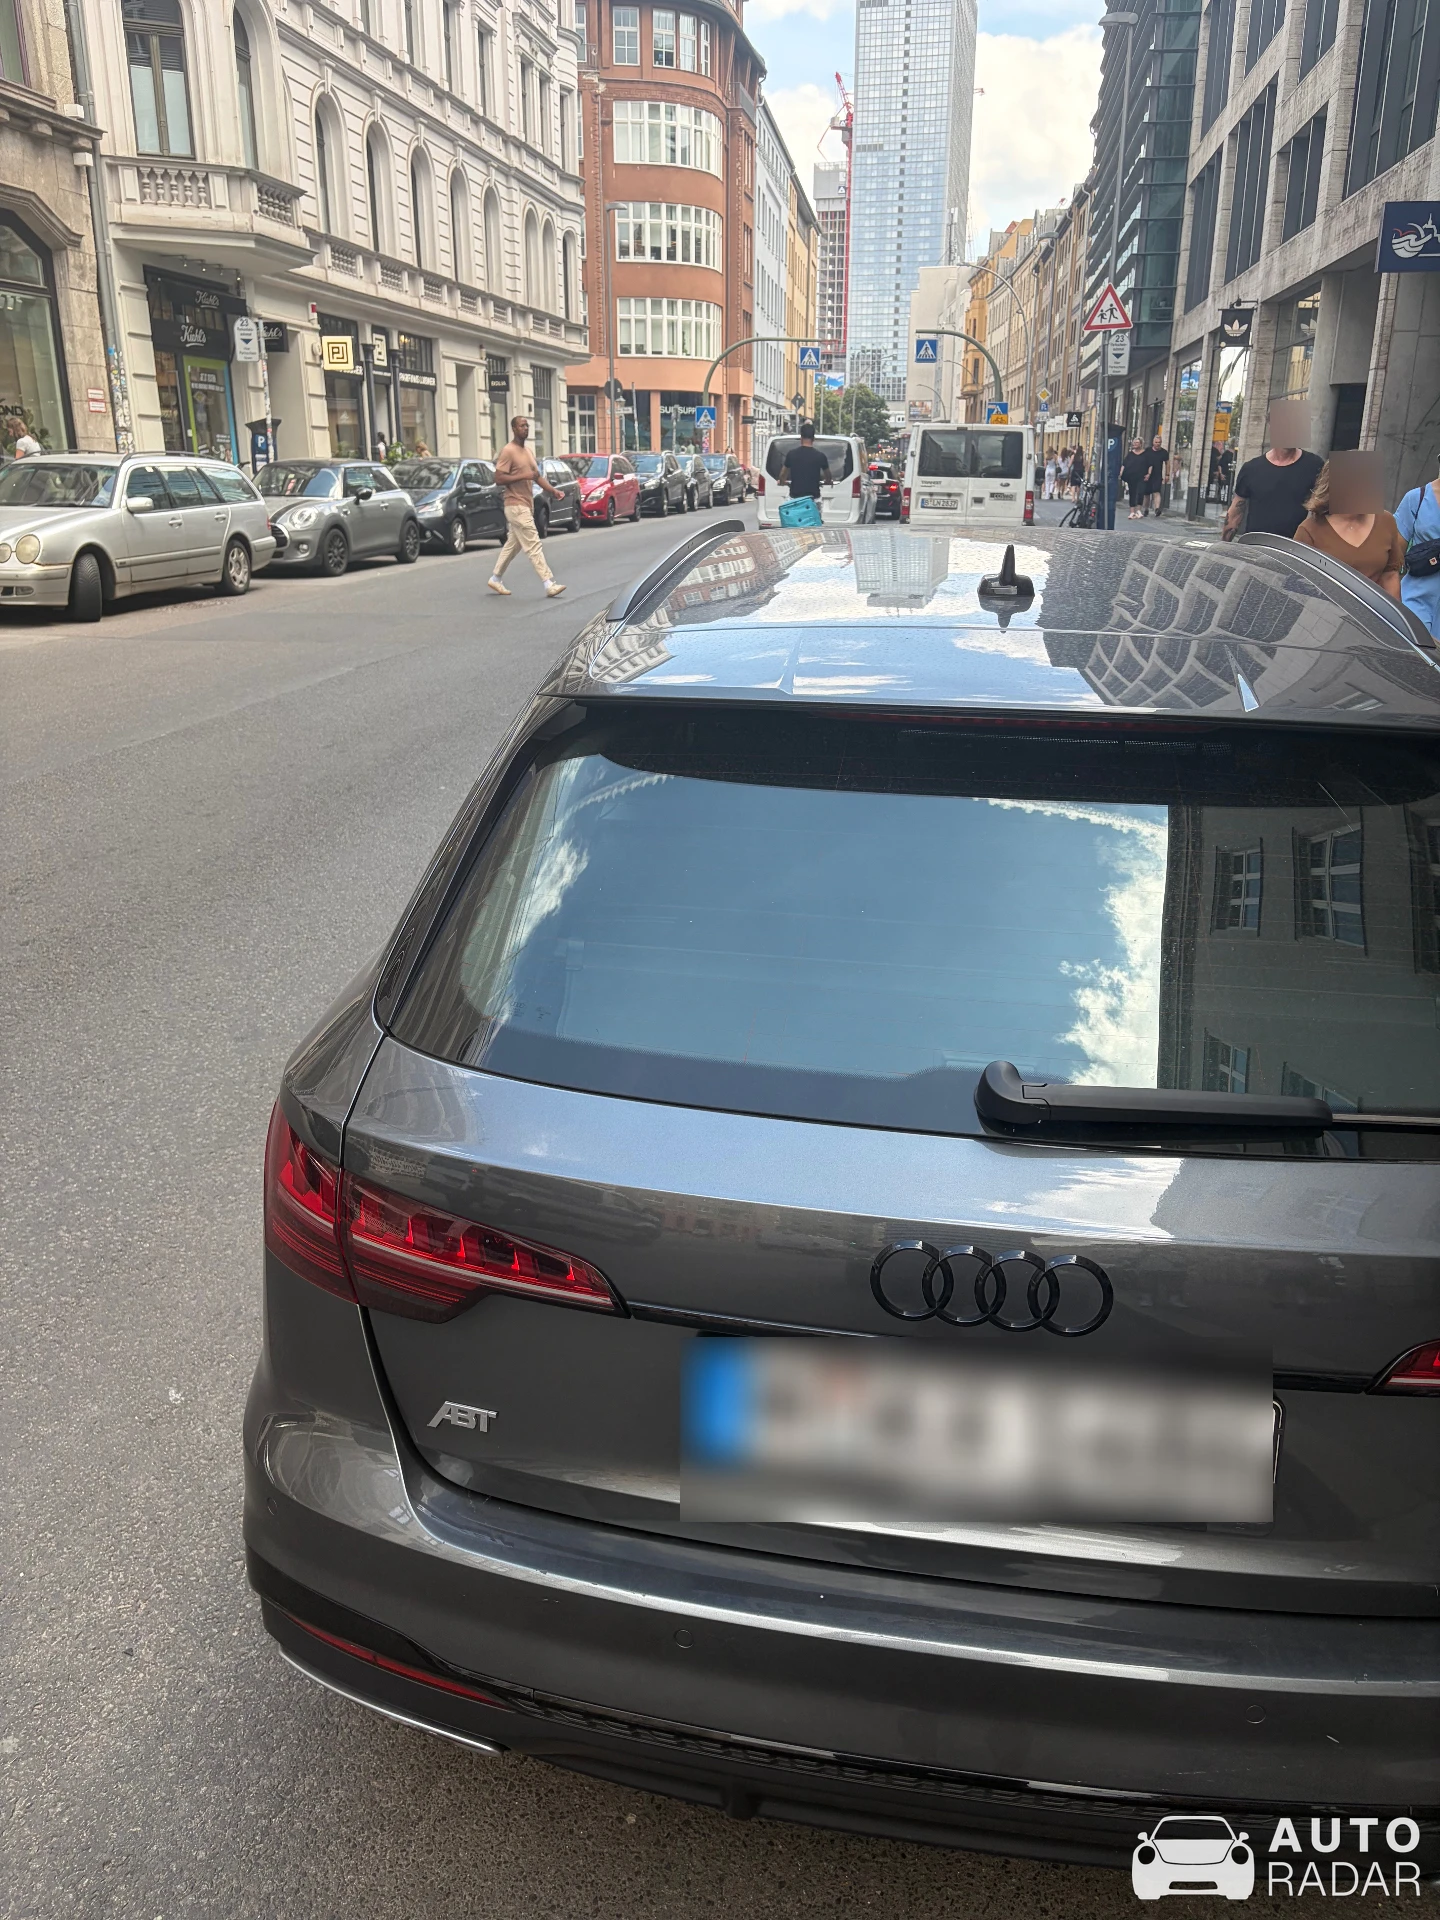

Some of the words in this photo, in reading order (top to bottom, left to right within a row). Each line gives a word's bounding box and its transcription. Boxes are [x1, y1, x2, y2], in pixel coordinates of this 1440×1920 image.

[195, 291, 219, 307] Kiehl's
[181, 325, 206, 345] Kiehl's
[258, 436, 265, 447] P
[1107, 439, 1115, 449] P
[427, 1401, 498, 1432] ABT
